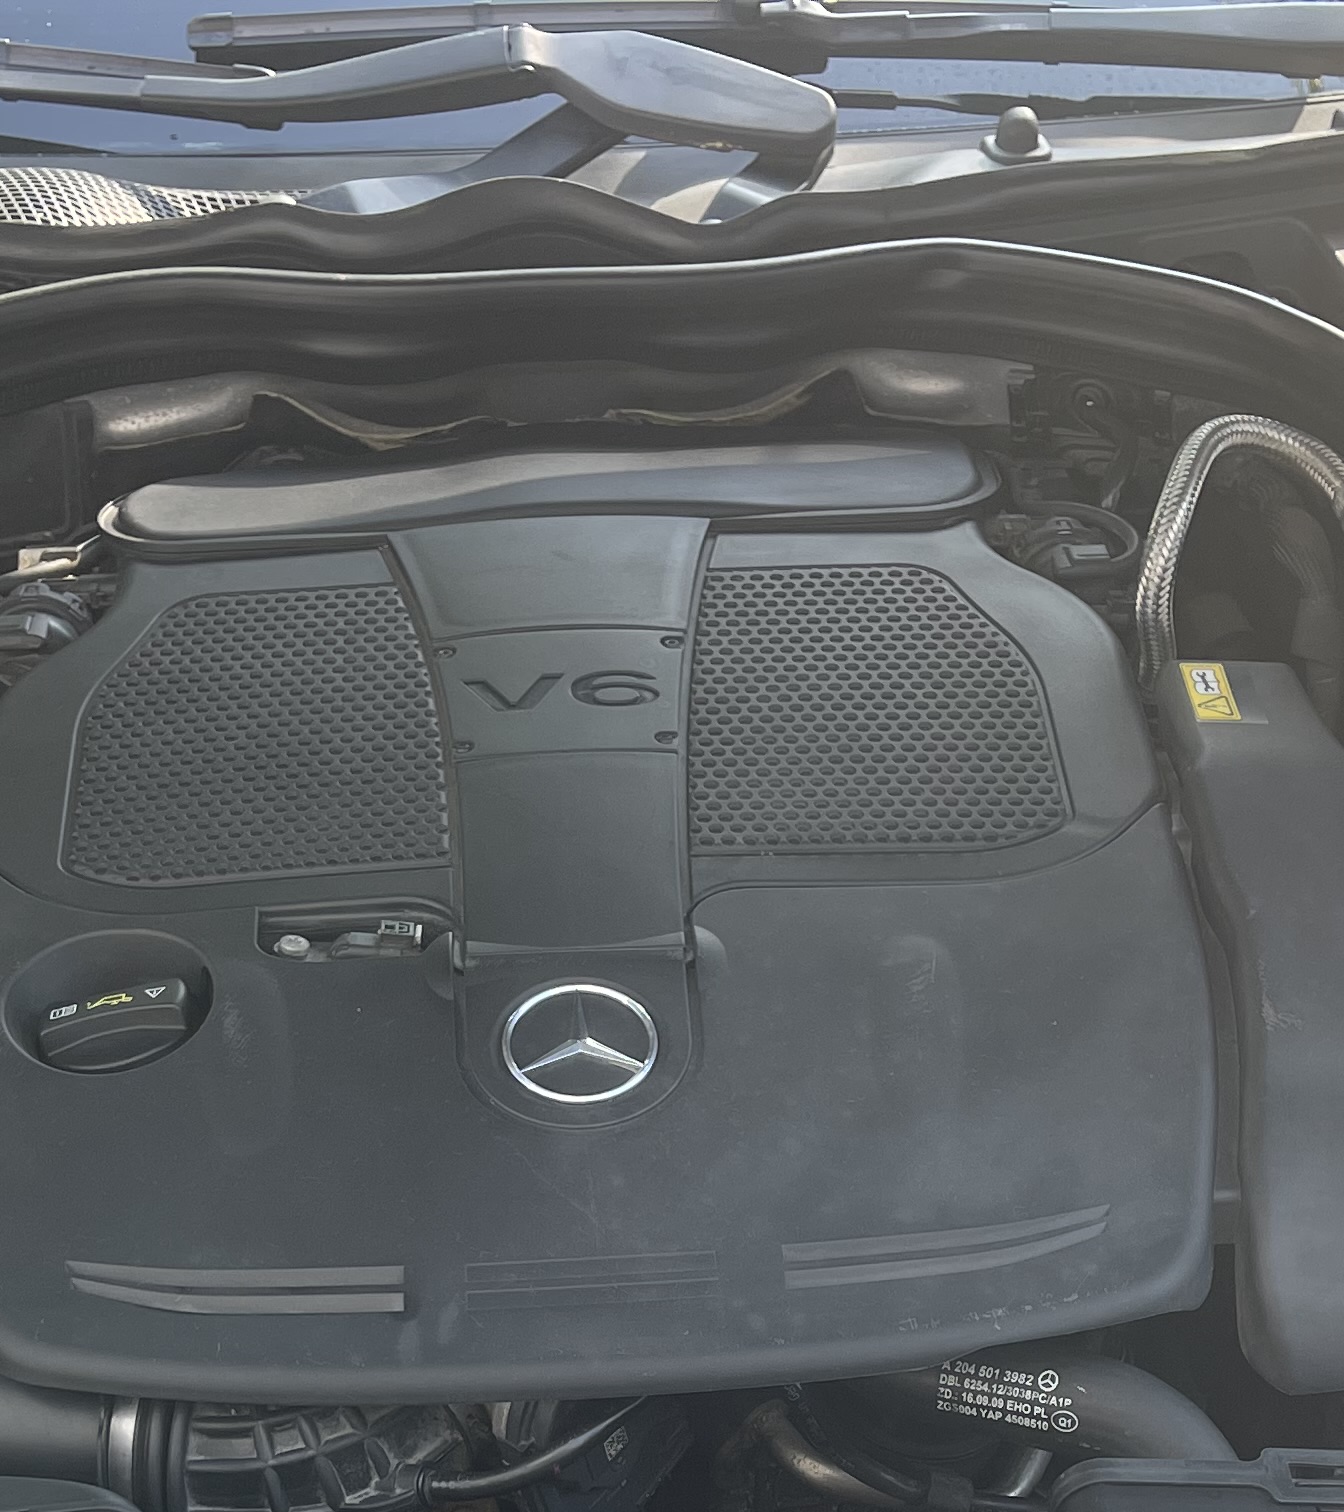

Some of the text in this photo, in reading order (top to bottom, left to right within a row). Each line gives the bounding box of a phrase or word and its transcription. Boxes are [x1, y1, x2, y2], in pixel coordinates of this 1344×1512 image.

[459, 669, 661, 713] V6
[939, 1373, 961, 1387] DBL
[941, 1361, 1035, 1386] A 204 501 3982
[936, 1400, 1049, 1431] ZGS004 YAP 4508510
[961, 1392, 1004, 1408] 16.09.09
[1007, 1401, 1031, 1414] EHO
[1033, 1406, 1049, 1419] PL
[1058, 1417, 1073, 1428] Q1
